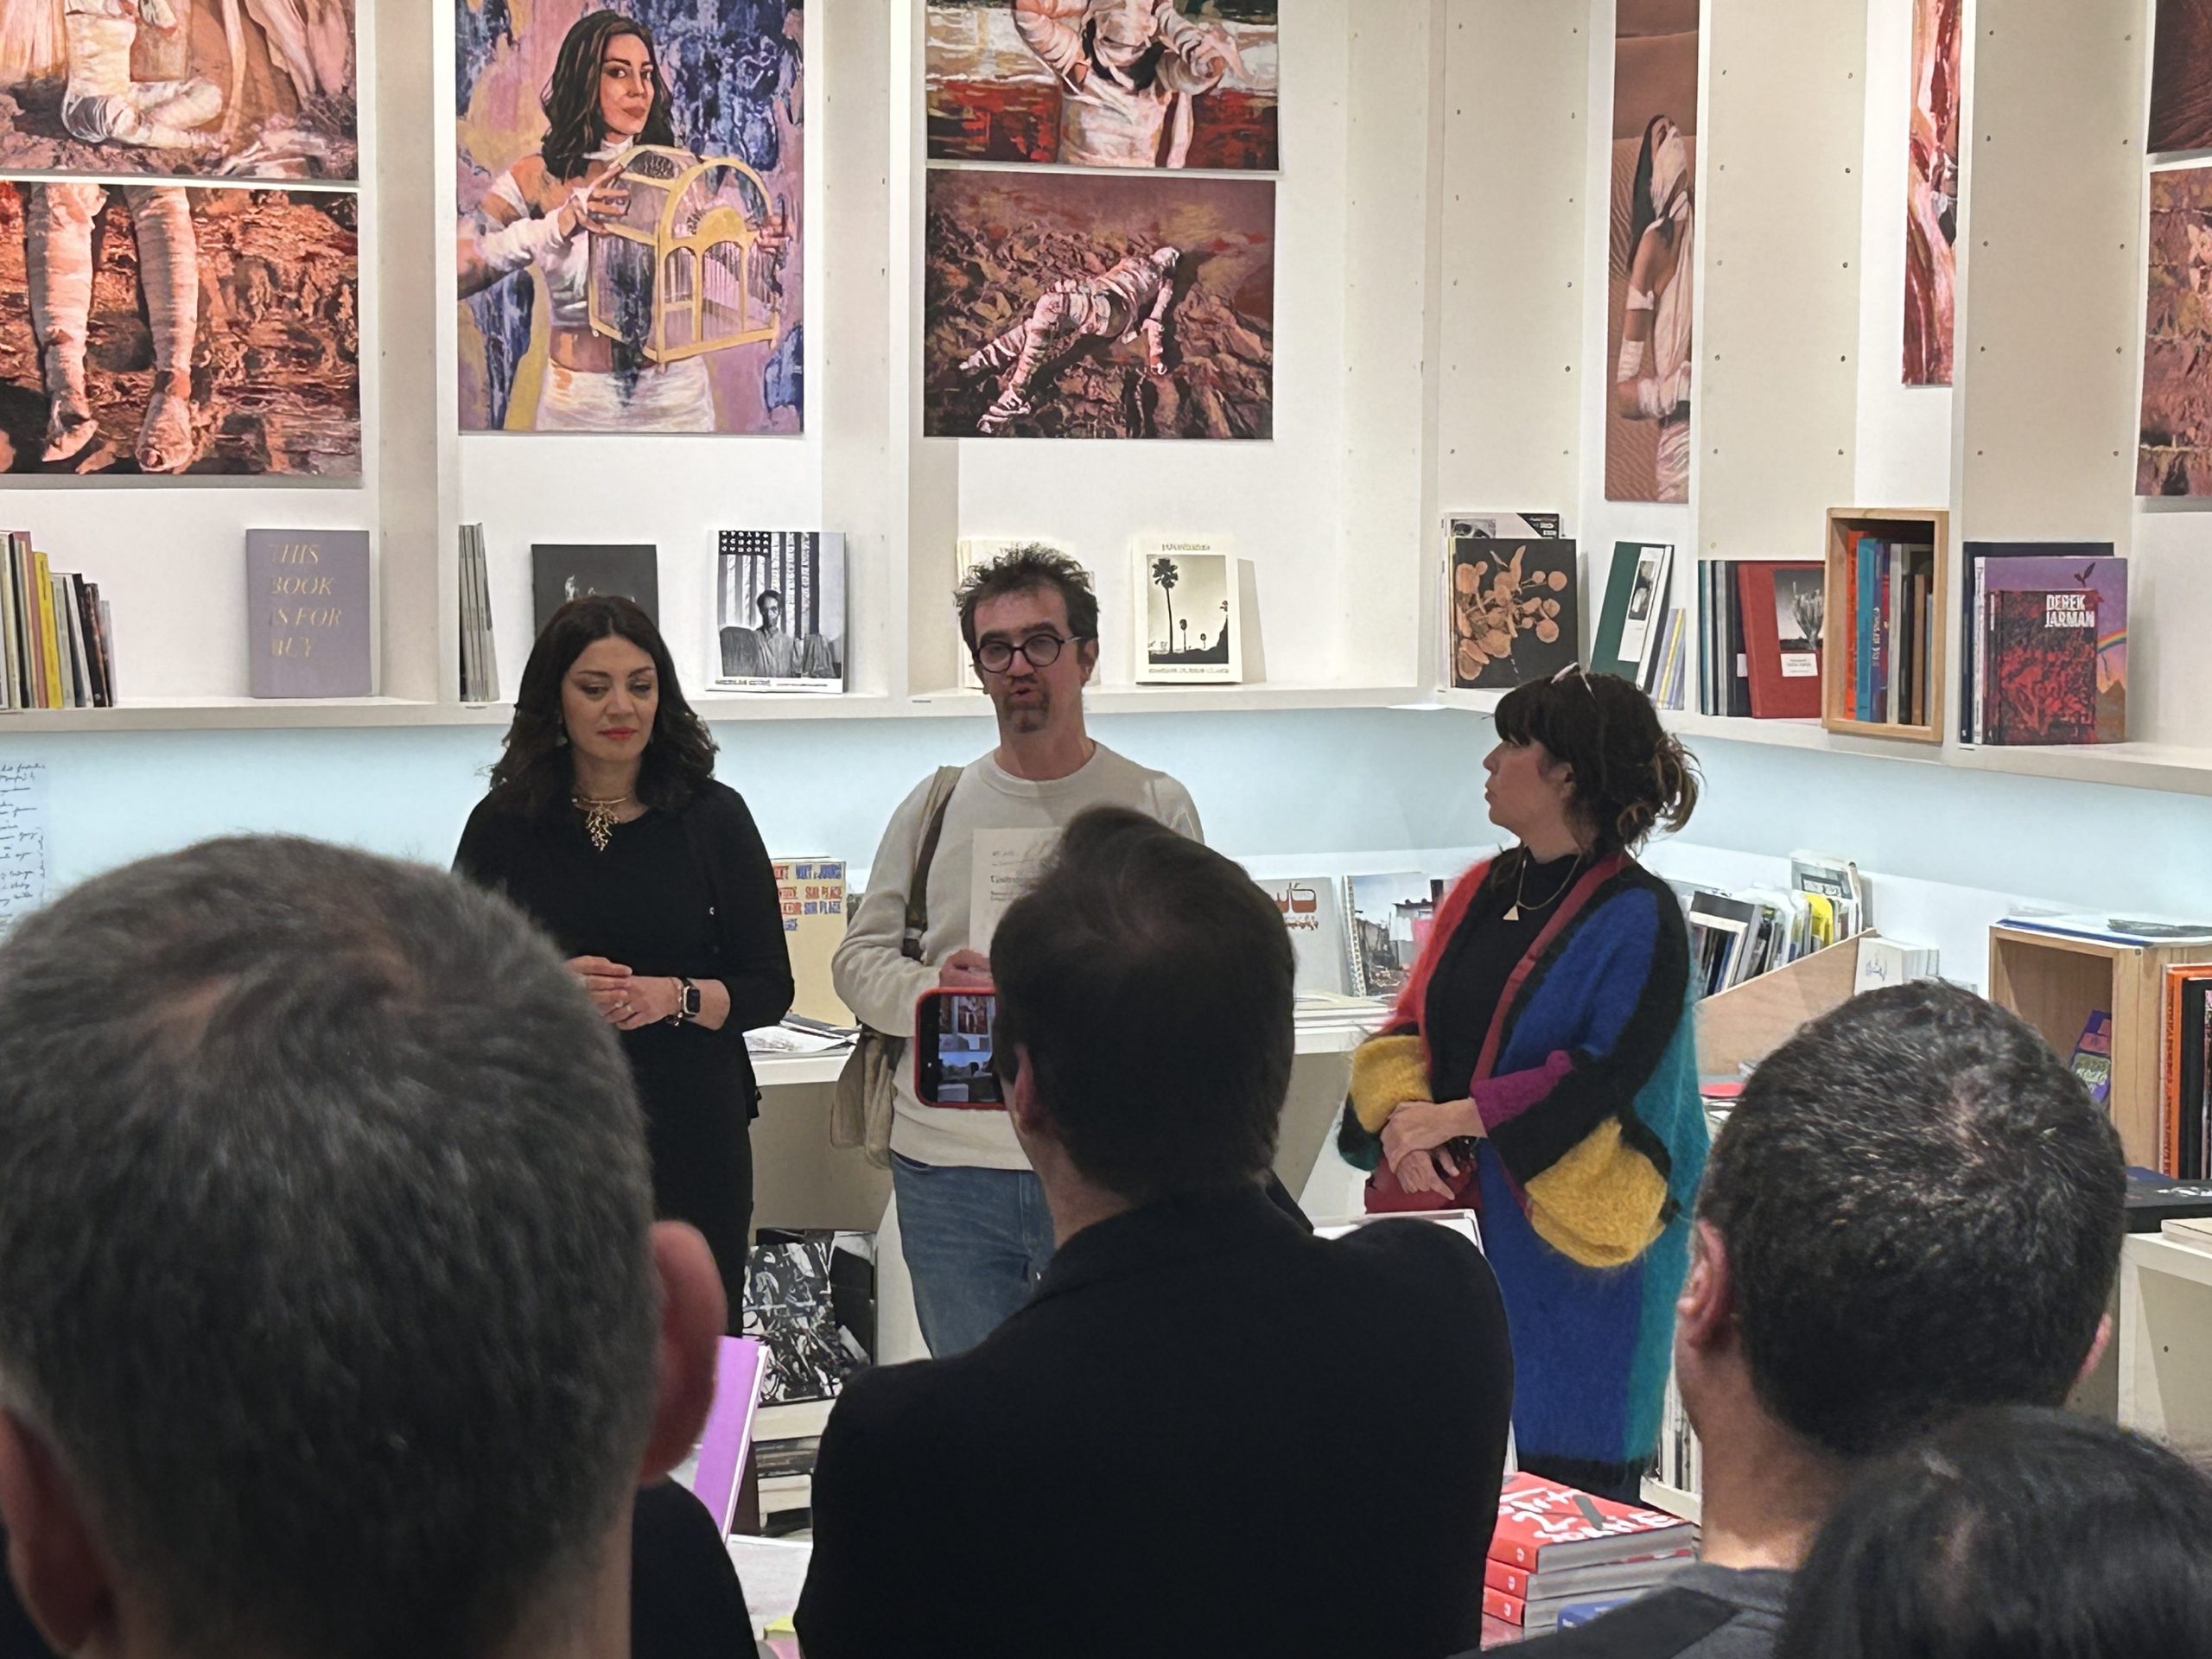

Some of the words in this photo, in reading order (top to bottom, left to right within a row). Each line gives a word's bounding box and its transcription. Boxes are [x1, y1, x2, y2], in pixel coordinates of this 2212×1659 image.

[270, 543, 319, 564] THIS
[271, 575, 334, 594] BOOK
[2046, 594, 2086, 610] DEREK
[270, 607, 289, 624] IS
[295, 607, 342, 626] FOR
[2044, 610, 2094, 628] JARMAN
